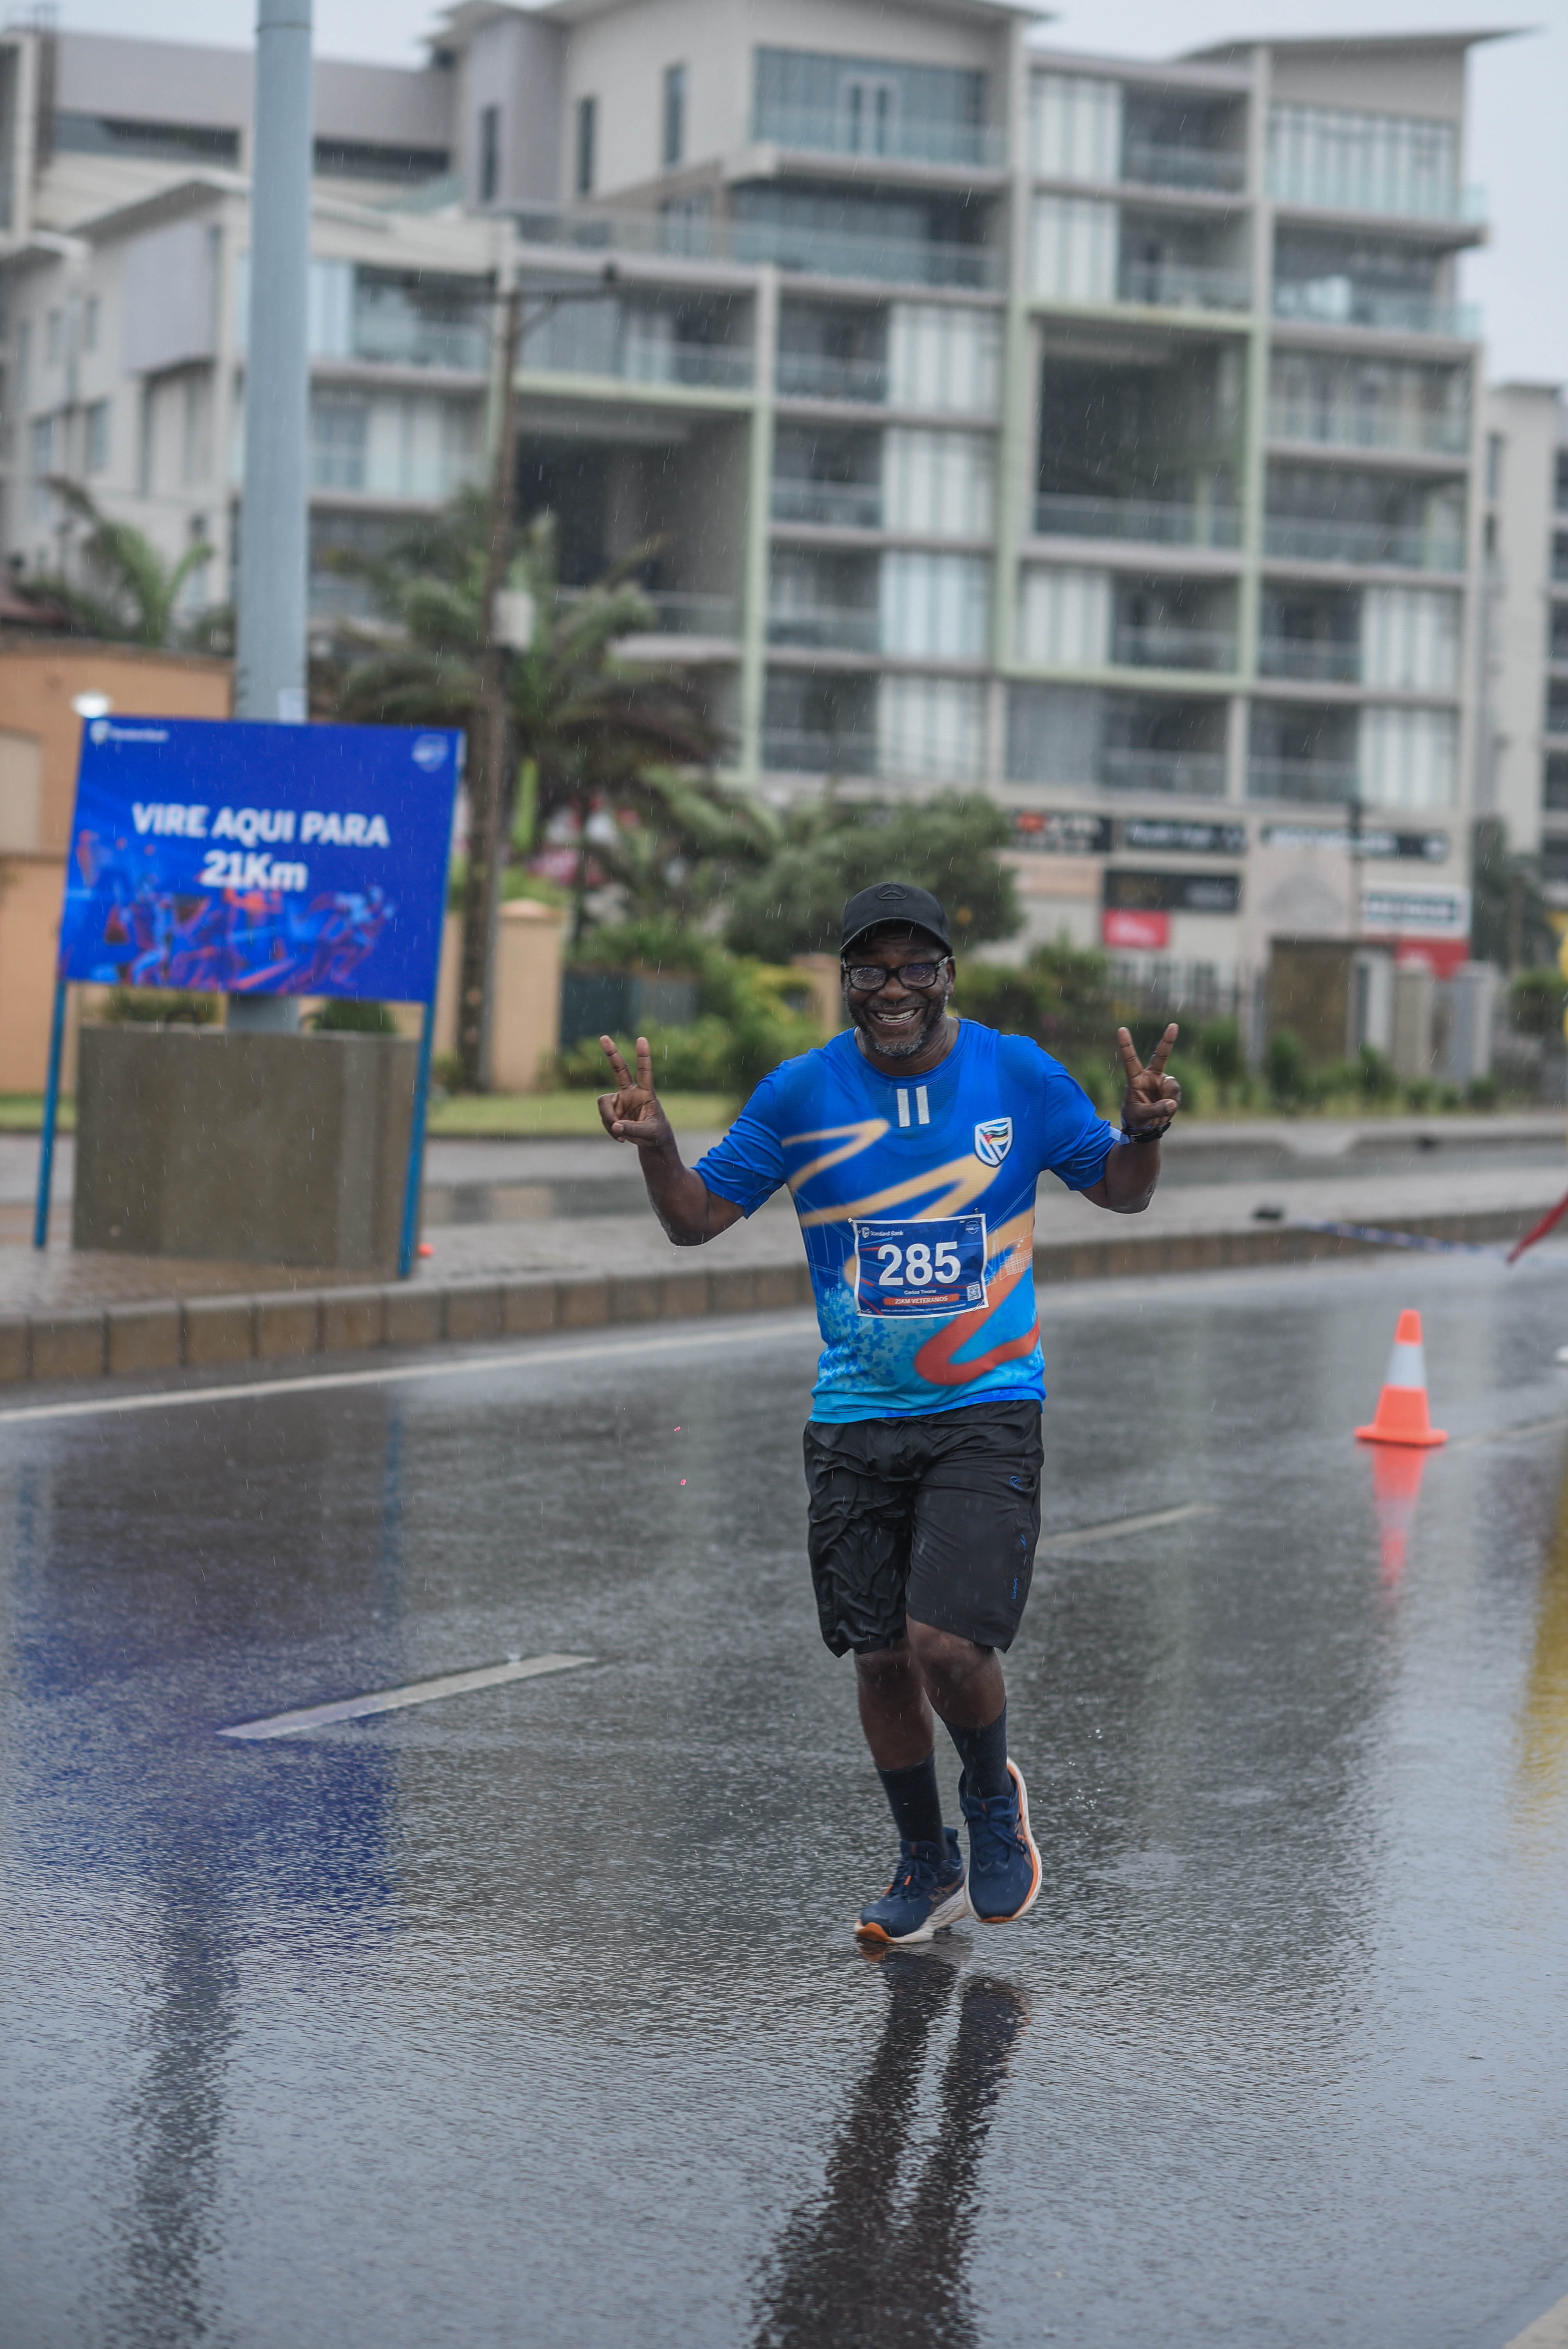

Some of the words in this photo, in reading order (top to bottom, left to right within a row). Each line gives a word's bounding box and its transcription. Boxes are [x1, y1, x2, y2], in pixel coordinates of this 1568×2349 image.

[132, 802, 210, 838] VIRE
[211, 806, 296, 848] AQUI
[300, 810, 390, 848] PARA
[200, 848, 308, 892] 21Km
[877, 1241, 961, 1285] 285
